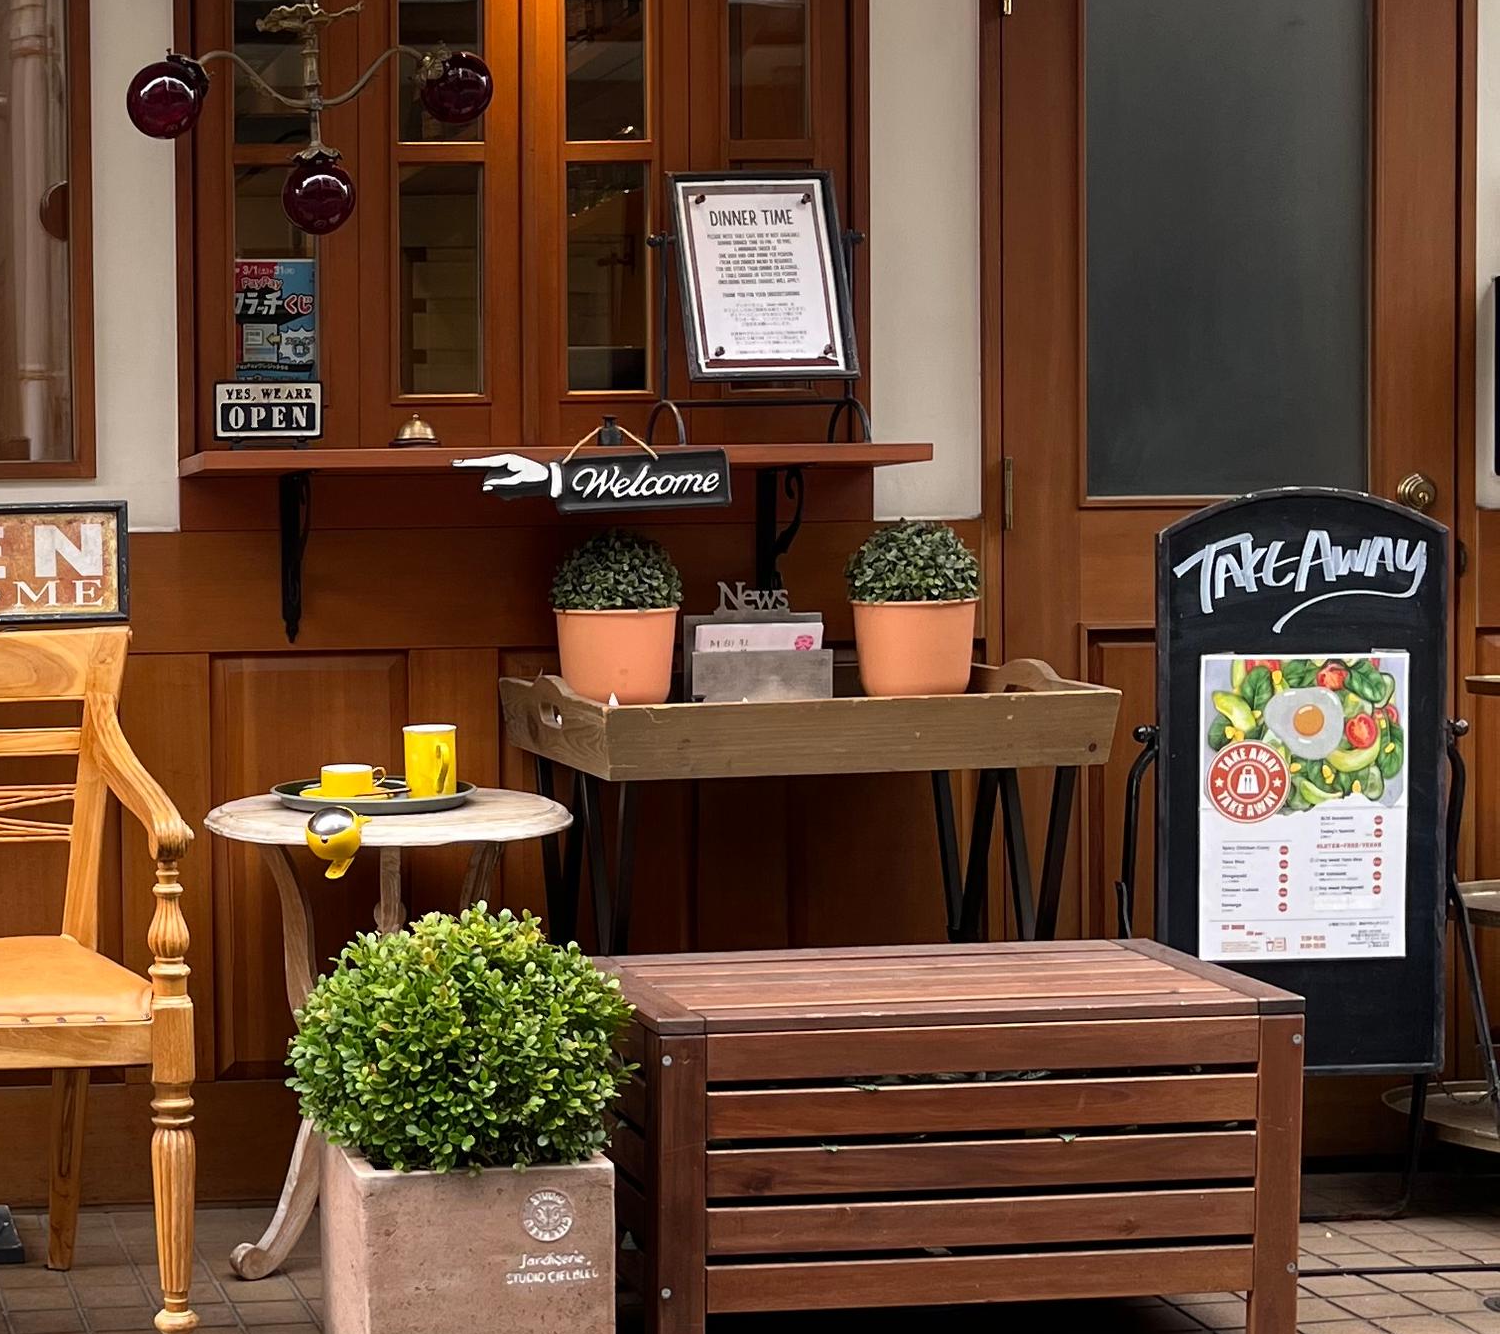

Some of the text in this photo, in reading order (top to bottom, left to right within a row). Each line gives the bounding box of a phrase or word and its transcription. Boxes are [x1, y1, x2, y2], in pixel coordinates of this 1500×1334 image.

[709, 209, 794, 227] DINNER TIME
[241, 276, 284, 291] PayPay
[226, 387, 313, 401] YES, WE ARE
[228, 405, 308, 429] OPEN
[572, 464, 720, 499] Welcome
[715, 581, 790, 612] News
[1218, 747, 1281, 773] TAKE AWAY
[1217, 790, 1279, 817] TAKE AWAY
[505, 1271, 546, 1285] STUDIO
